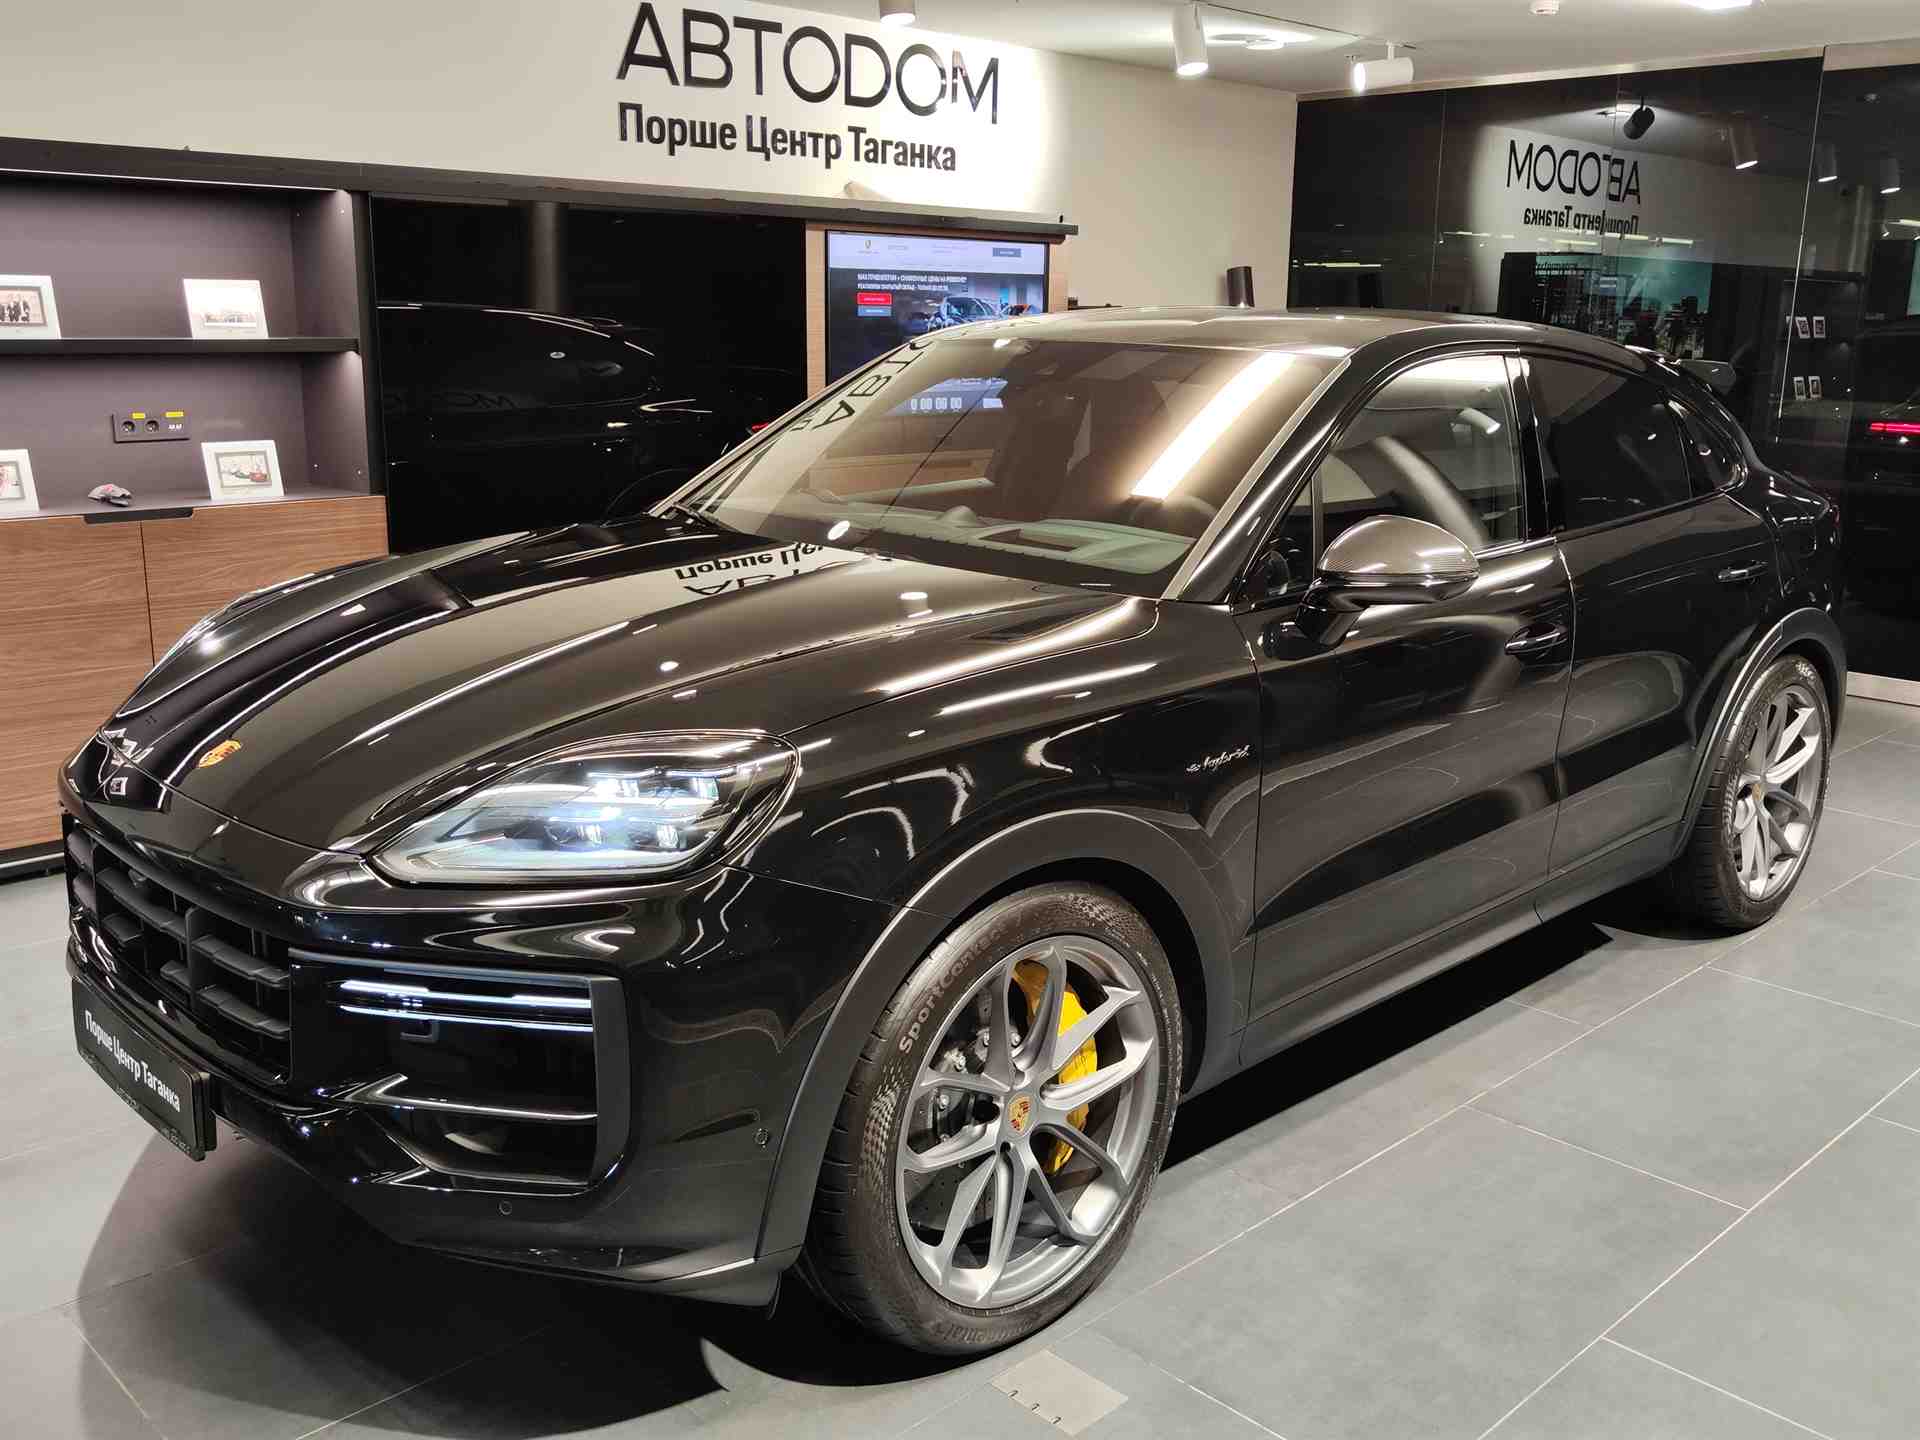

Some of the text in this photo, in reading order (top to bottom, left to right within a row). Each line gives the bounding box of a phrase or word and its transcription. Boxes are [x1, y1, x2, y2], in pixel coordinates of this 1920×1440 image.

[618, 102, 956, 171] Порше Центр Таганка
[84, 1009, 113, 1052] Порше
[113, 1035, 141, 1082] Центр
[141, 1060, 181, 1113] Таганка
